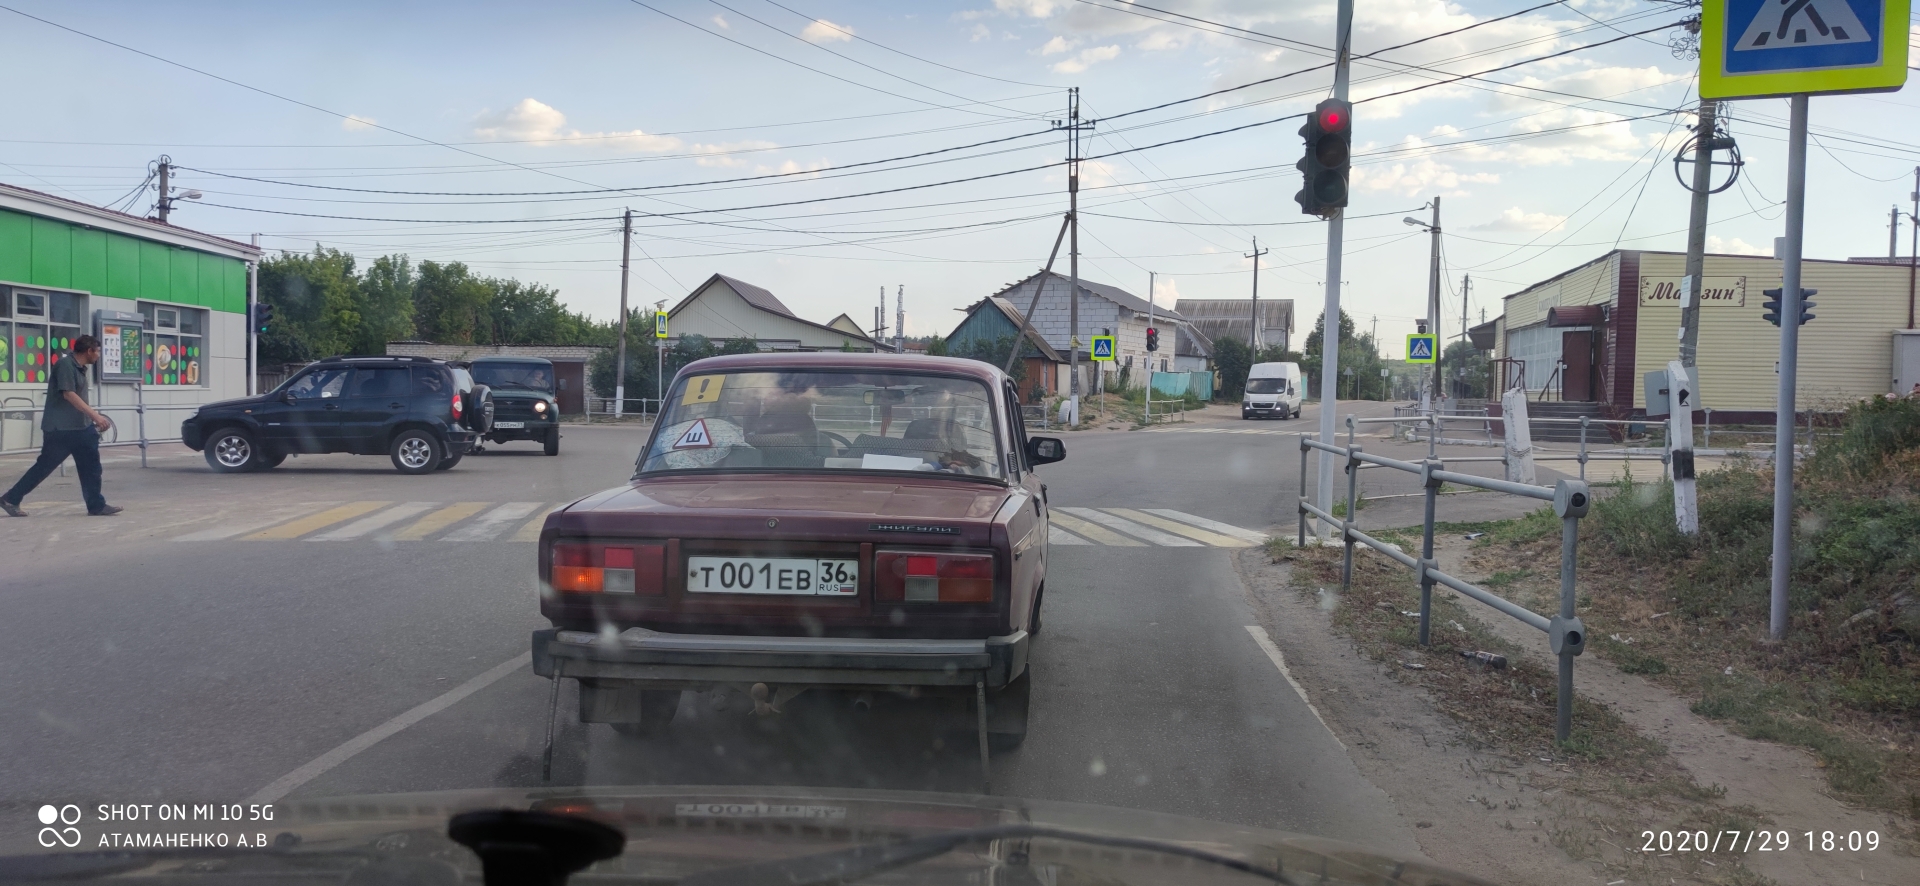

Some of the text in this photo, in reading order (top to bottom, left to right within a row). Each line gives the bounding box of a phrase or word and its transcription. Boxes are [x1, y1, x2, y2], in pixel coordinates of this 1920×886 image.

[1648, 281, 1735, 300] Мазин
[685, 431, 703, 443] Ш
[821, 562, 848, 583] 36
[819, 584, 839, 592] RUS
